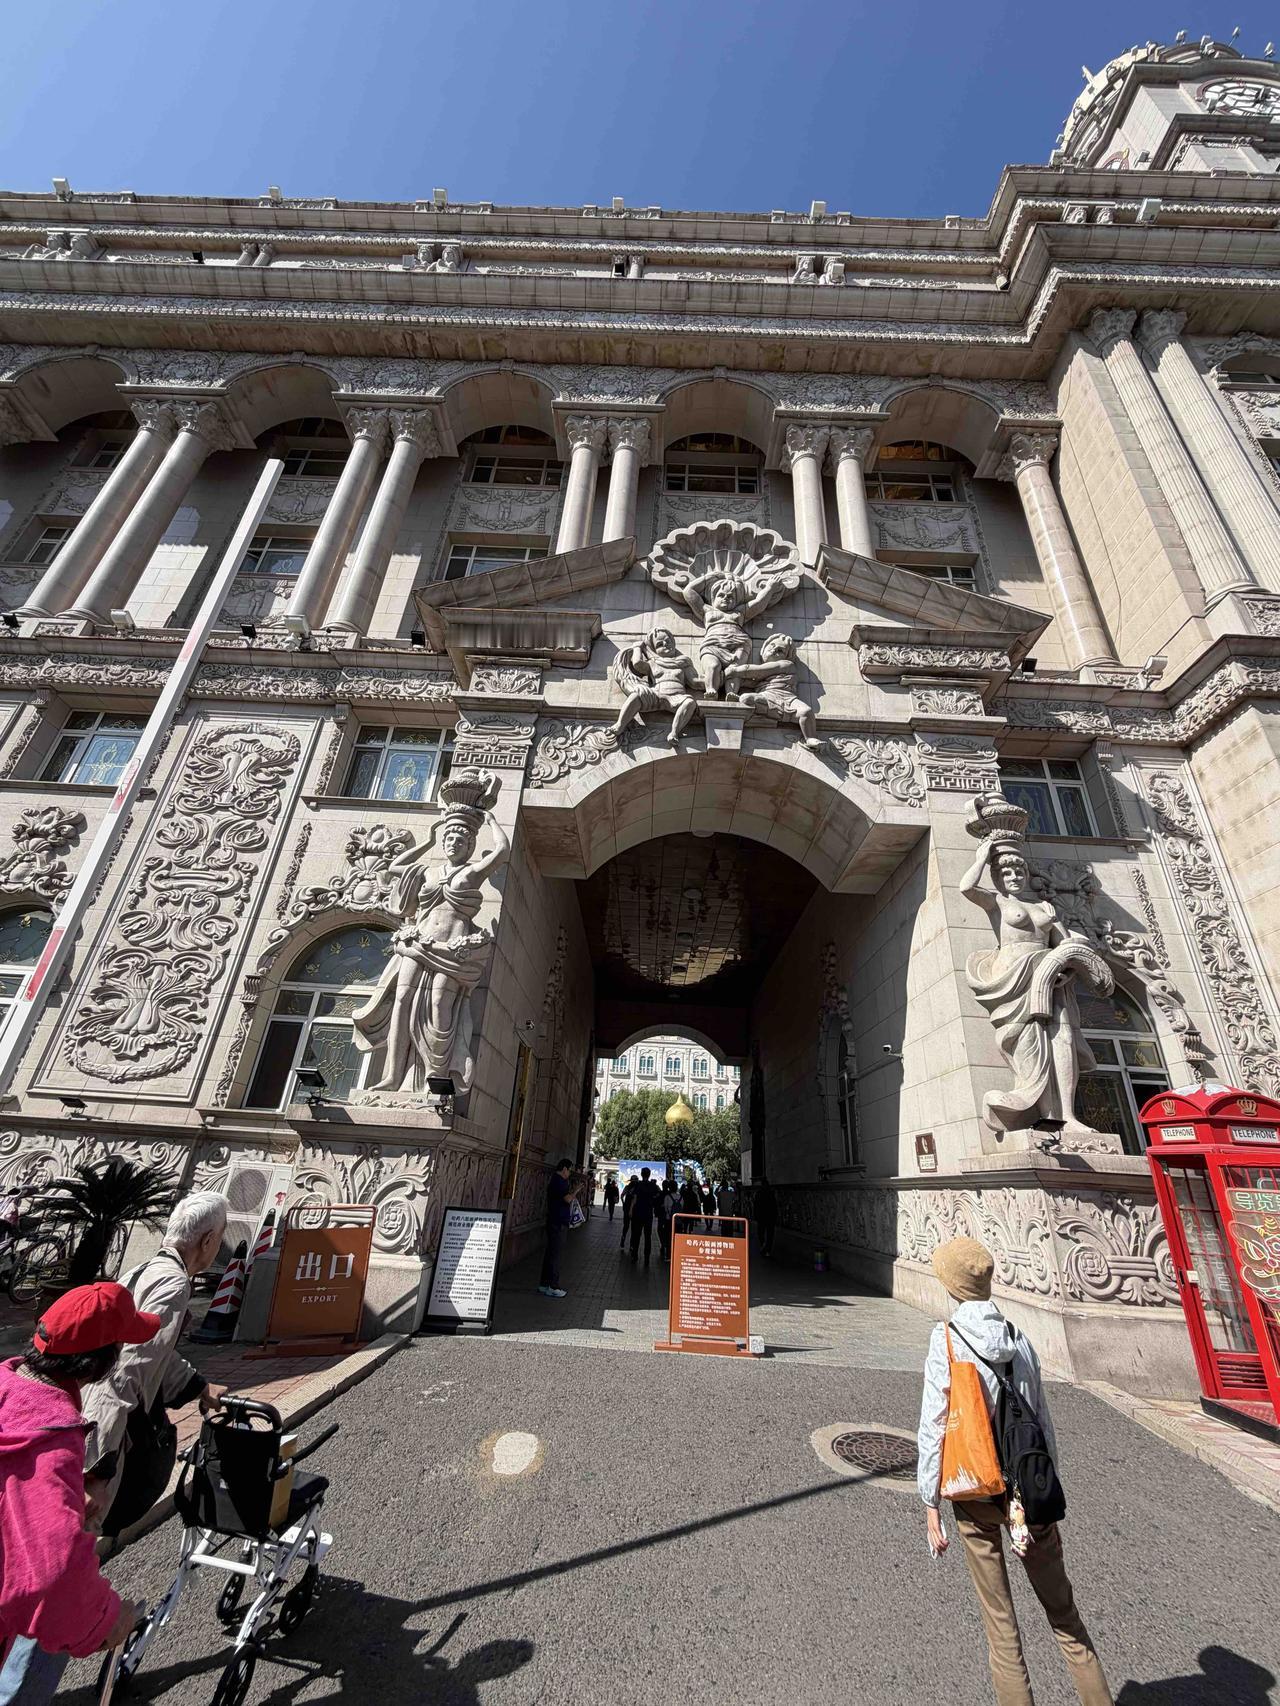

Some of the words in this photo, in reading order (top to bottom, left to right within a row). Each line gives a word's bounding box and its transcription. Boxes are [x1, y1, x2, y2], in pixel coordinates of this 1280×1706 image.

[1163, 1129, 1195, 1137] TELEPHONE
[1232, 1129, 1276, 1139] TELEPHONE
[1235, 1191, 1280, 1211] 导览
[295, 1252, 355, 1280] 出口
[302, 1295, 337, 1303] EXPORT
